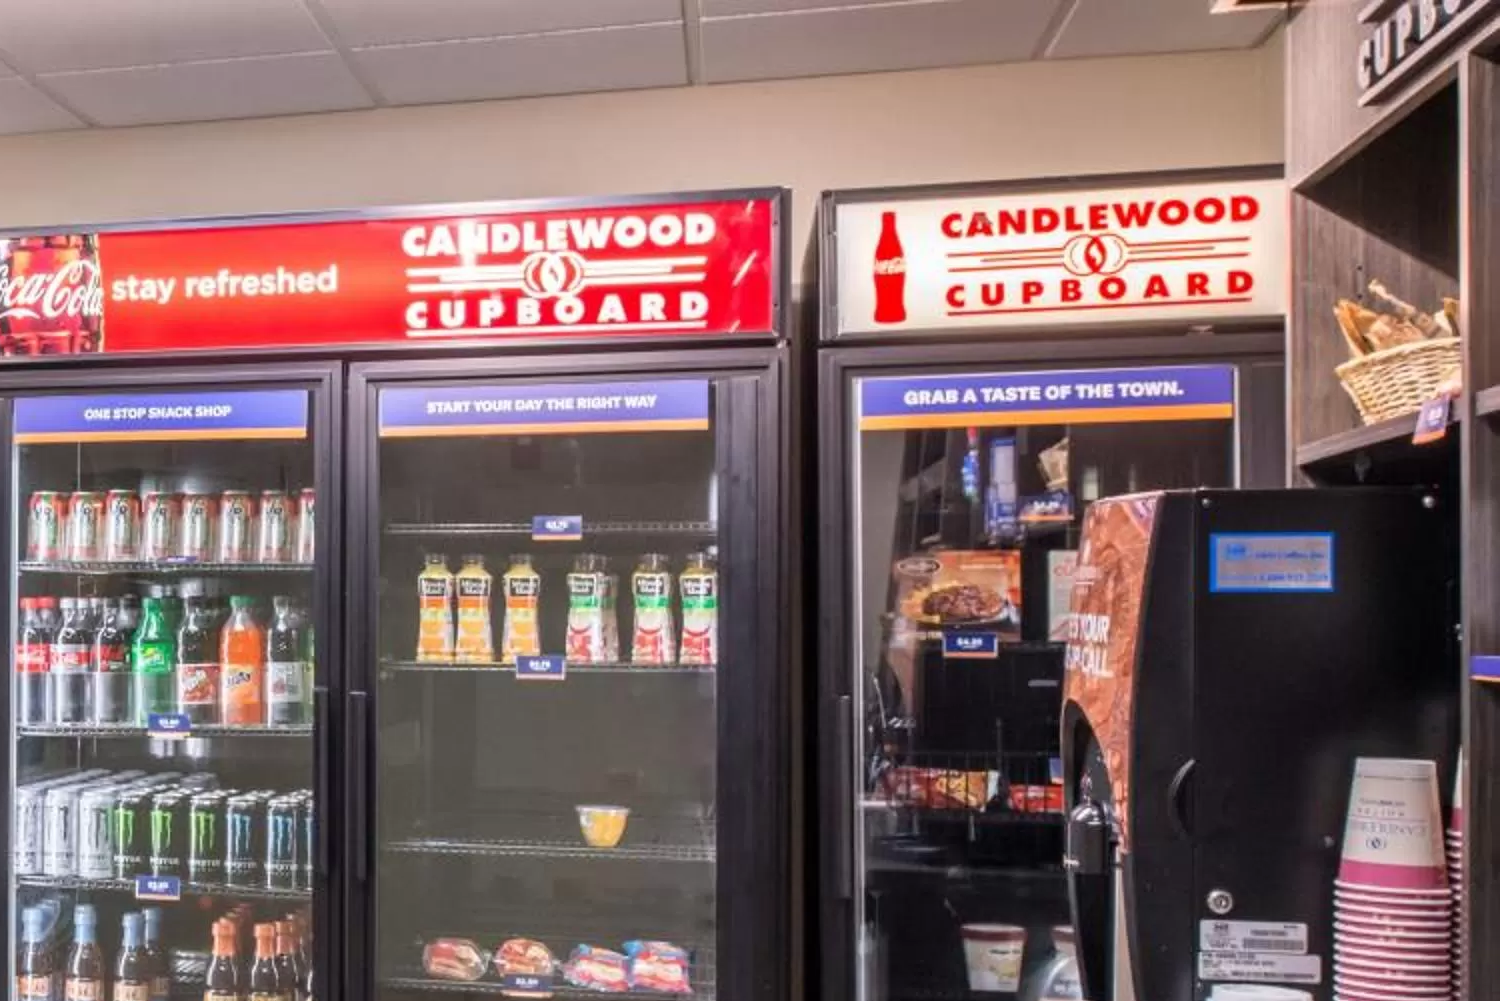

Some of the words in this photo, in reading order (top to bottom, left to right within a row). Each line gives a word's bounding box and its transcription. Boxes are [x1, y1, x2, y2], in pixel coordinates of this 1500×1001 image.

[402, 213, 717, 257] CANDLEWOOD
[941, 196, 1259, 238] CANDLEWOOD
[112, 272, 174, 306] stay
[184, 263, 338, 301] refreshed
[946, 269, 1255, 308] CUPBOARD
[406, 292, 710, 329] CUPBOARD
[84, 407, 110, 420] ONE
[113, 407, 146, 420] STOP
[148, 405, 192, 419] SNACK
[195, 404, 233, 417] SHOP
[427, 401, 469, 415] START
[474, 400, 512, 413] YOUR
[515, 399, 543, 412] DAY
[546, 398, 574, 411] THE
[577, 396, 621, 410] RIGHT
[624, 394, 658, 408] WAY
[903, 389, 958, 406] GRAB
[963, 388, 977, 404] A
[981, 386, 1041, 402] TASTE
[1045, 384, 1072, 400] OF
[1075, 383, 1113, 399] THE
[1118, 381, 1185, 397] TOWN.
